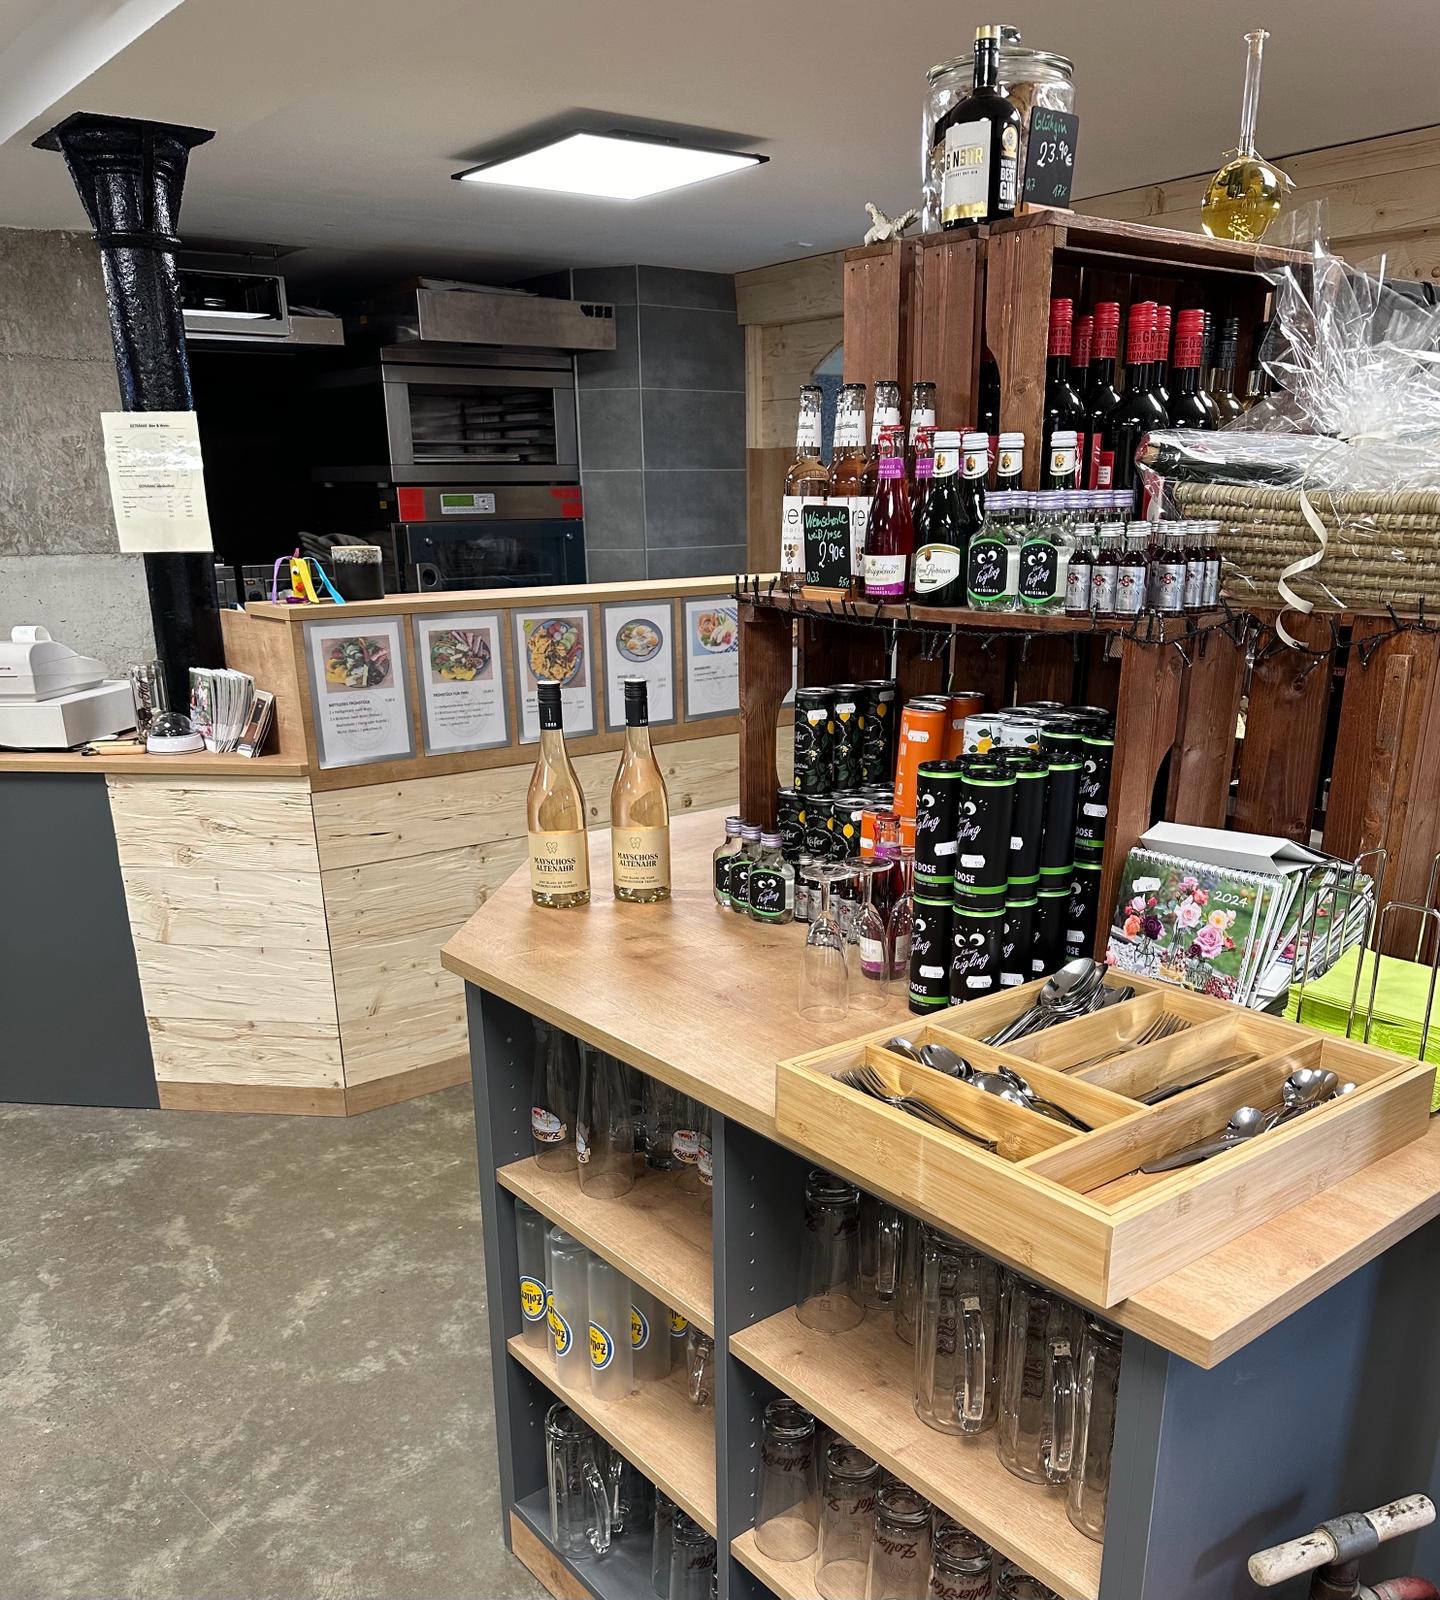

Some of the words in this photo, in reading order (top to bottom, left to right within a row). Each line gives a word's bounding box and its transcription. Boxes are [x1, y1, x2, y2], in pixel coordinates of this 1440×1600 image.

[1001, 168, 1016, 181] BEST
[1000, 182, 1015, 200] GIN
[534, 857, 576, 865] MAYSCHOSS
[617, 852, 659, 860] MAYSCHOSS
[917, 863, 936, 873] DOSE
[957, 873, 975, 884] DOSE
[1213, 890, 1248, 909] 2024
[952, 951, 990, 975] Feigling
